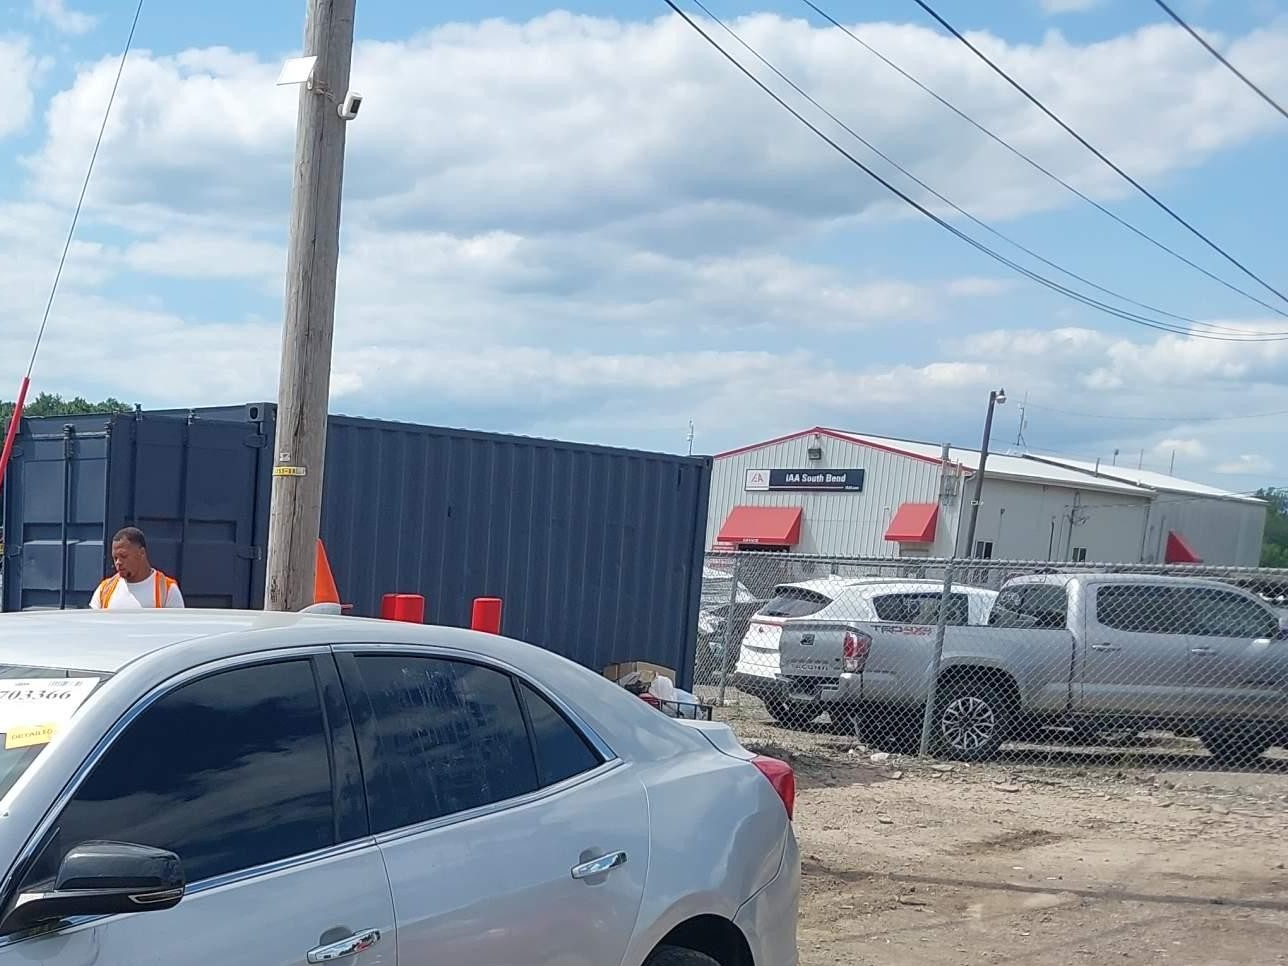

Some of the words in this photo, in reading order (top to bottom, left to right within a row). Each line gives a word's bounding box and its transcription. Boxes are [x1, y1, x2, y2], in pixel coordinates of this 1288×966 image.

[785, 474, 800, 482] IAA
[801, 473, 824, 483] South
[825, 473, 847, 483] Bend
